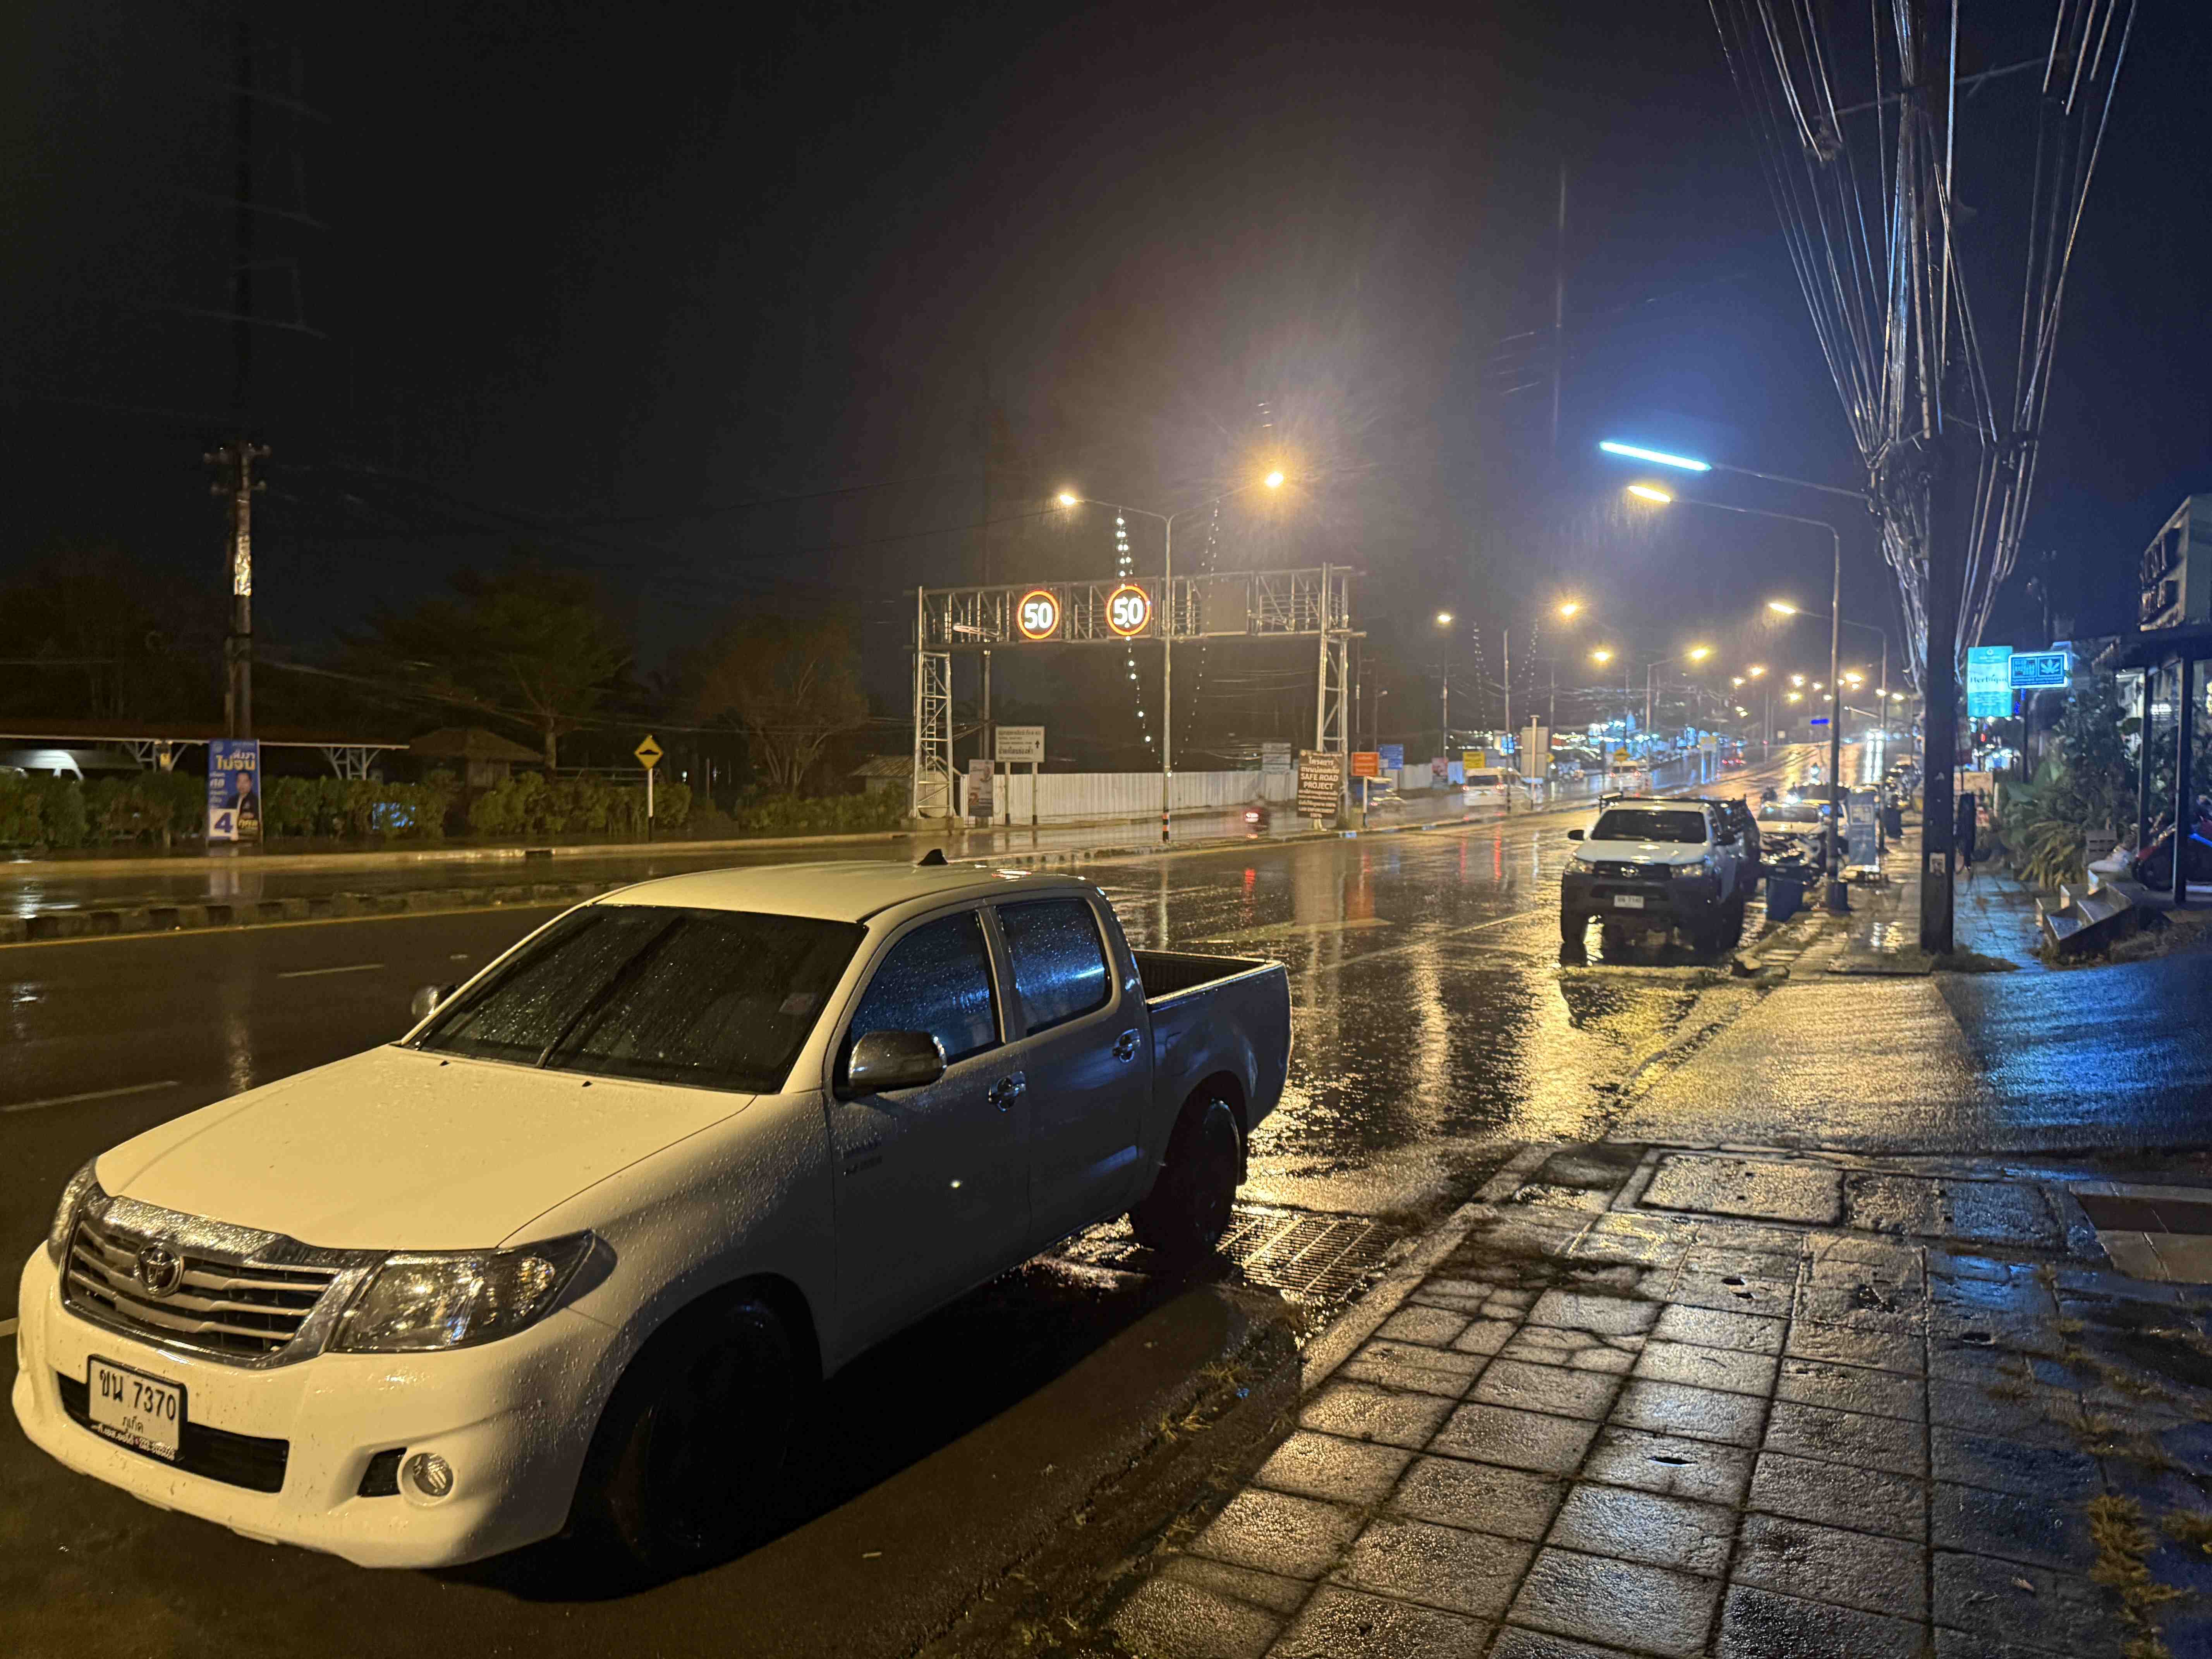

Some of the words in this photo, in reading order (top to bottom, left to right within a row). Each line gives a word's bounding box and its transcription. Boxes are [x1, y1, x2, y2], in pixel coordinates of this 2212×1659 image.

[1024, 602, 1053, 629] 50
[1113, 597, 1143, 625] 50
[1304, 781, 1333, 790] PROJECT
[214, 812, 234, 833] 4
[134, 1381, 176, 1421] 7370
[122, 1415, 144, 1433] ภูเก็ต
